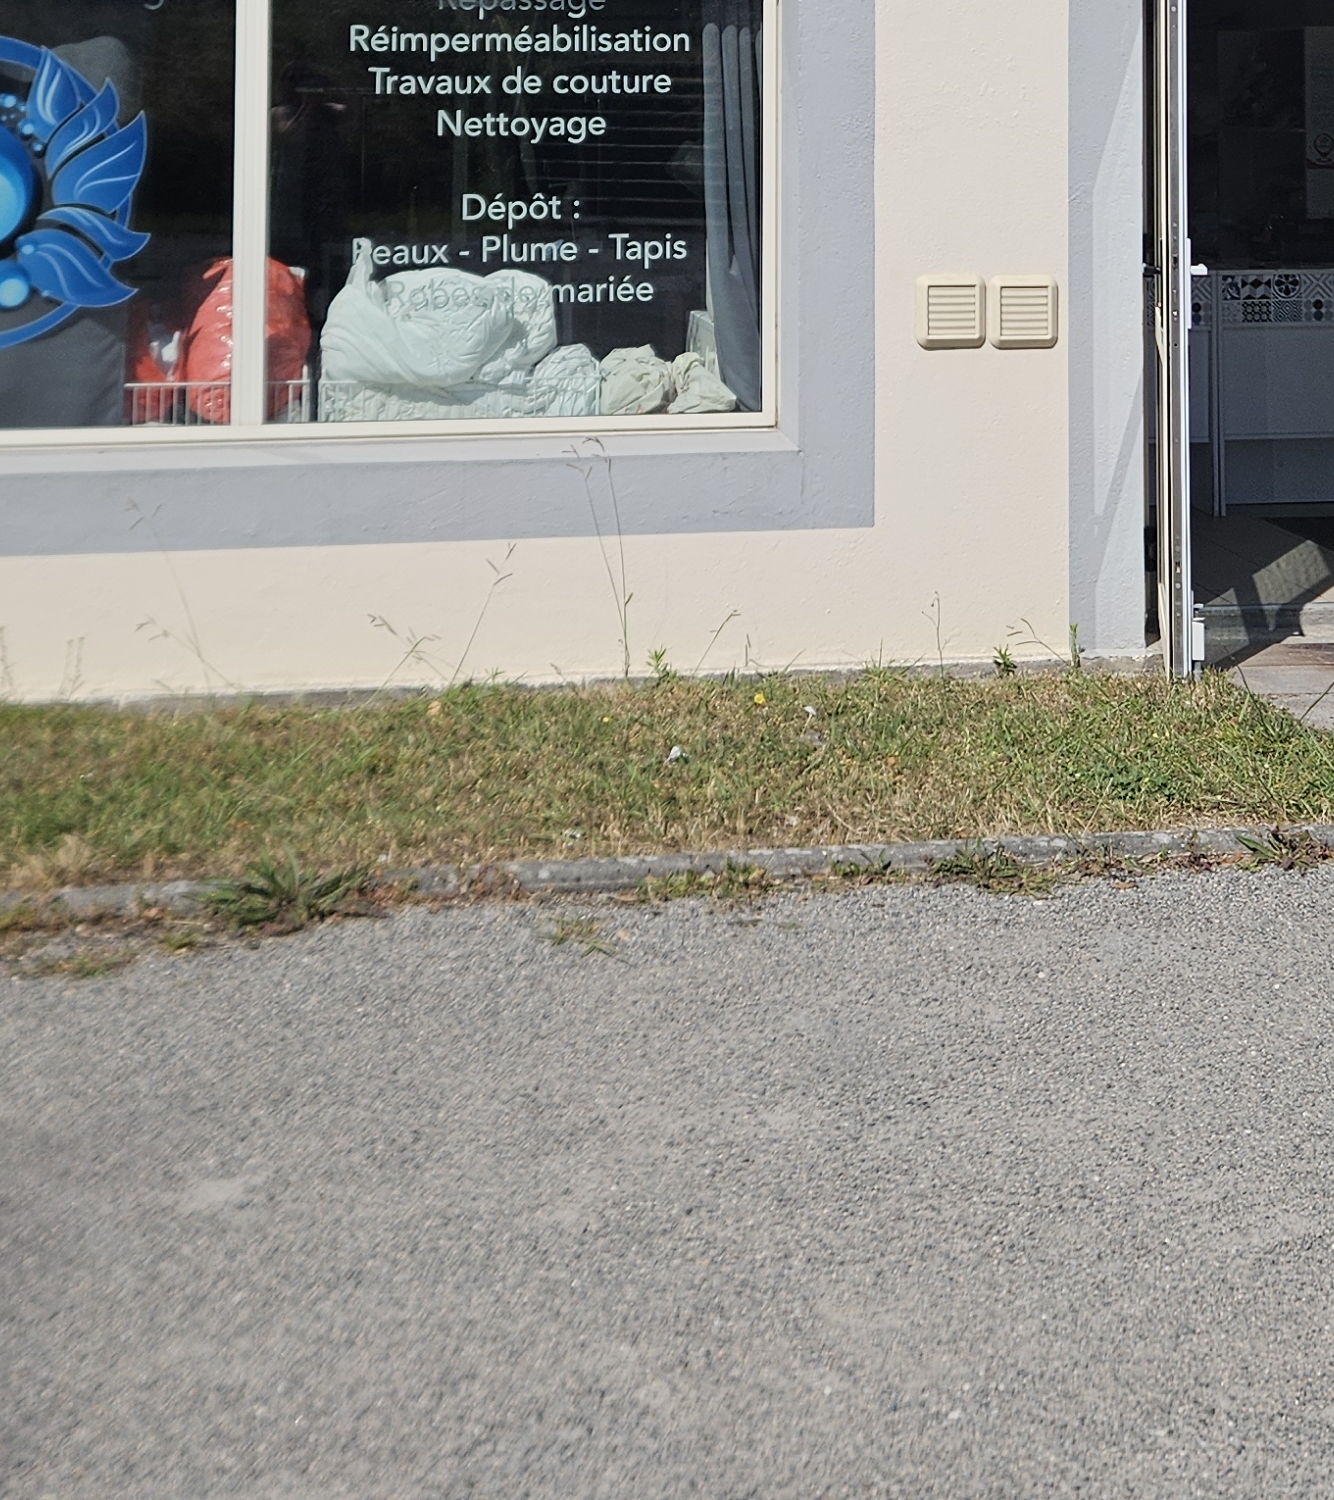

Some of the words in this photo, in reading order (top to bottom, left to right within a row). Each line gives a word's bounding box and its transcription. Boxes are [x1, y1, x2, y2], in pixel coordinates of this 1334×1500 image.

[349, 25, 691, 62] Réimperméabilisation
[368, 67, 492, 95] Travaux
[502, 66, 543, 95] de
[553, 70, 672, 95] couture
[437, 109, 607, 144] Nettoyage
[461, 192, 562, 229] Dépôt
[482, 235, 578, 263] Plume
[608, 233, 688, 269] Tapis
[548, 275, 655, 304] mariée
